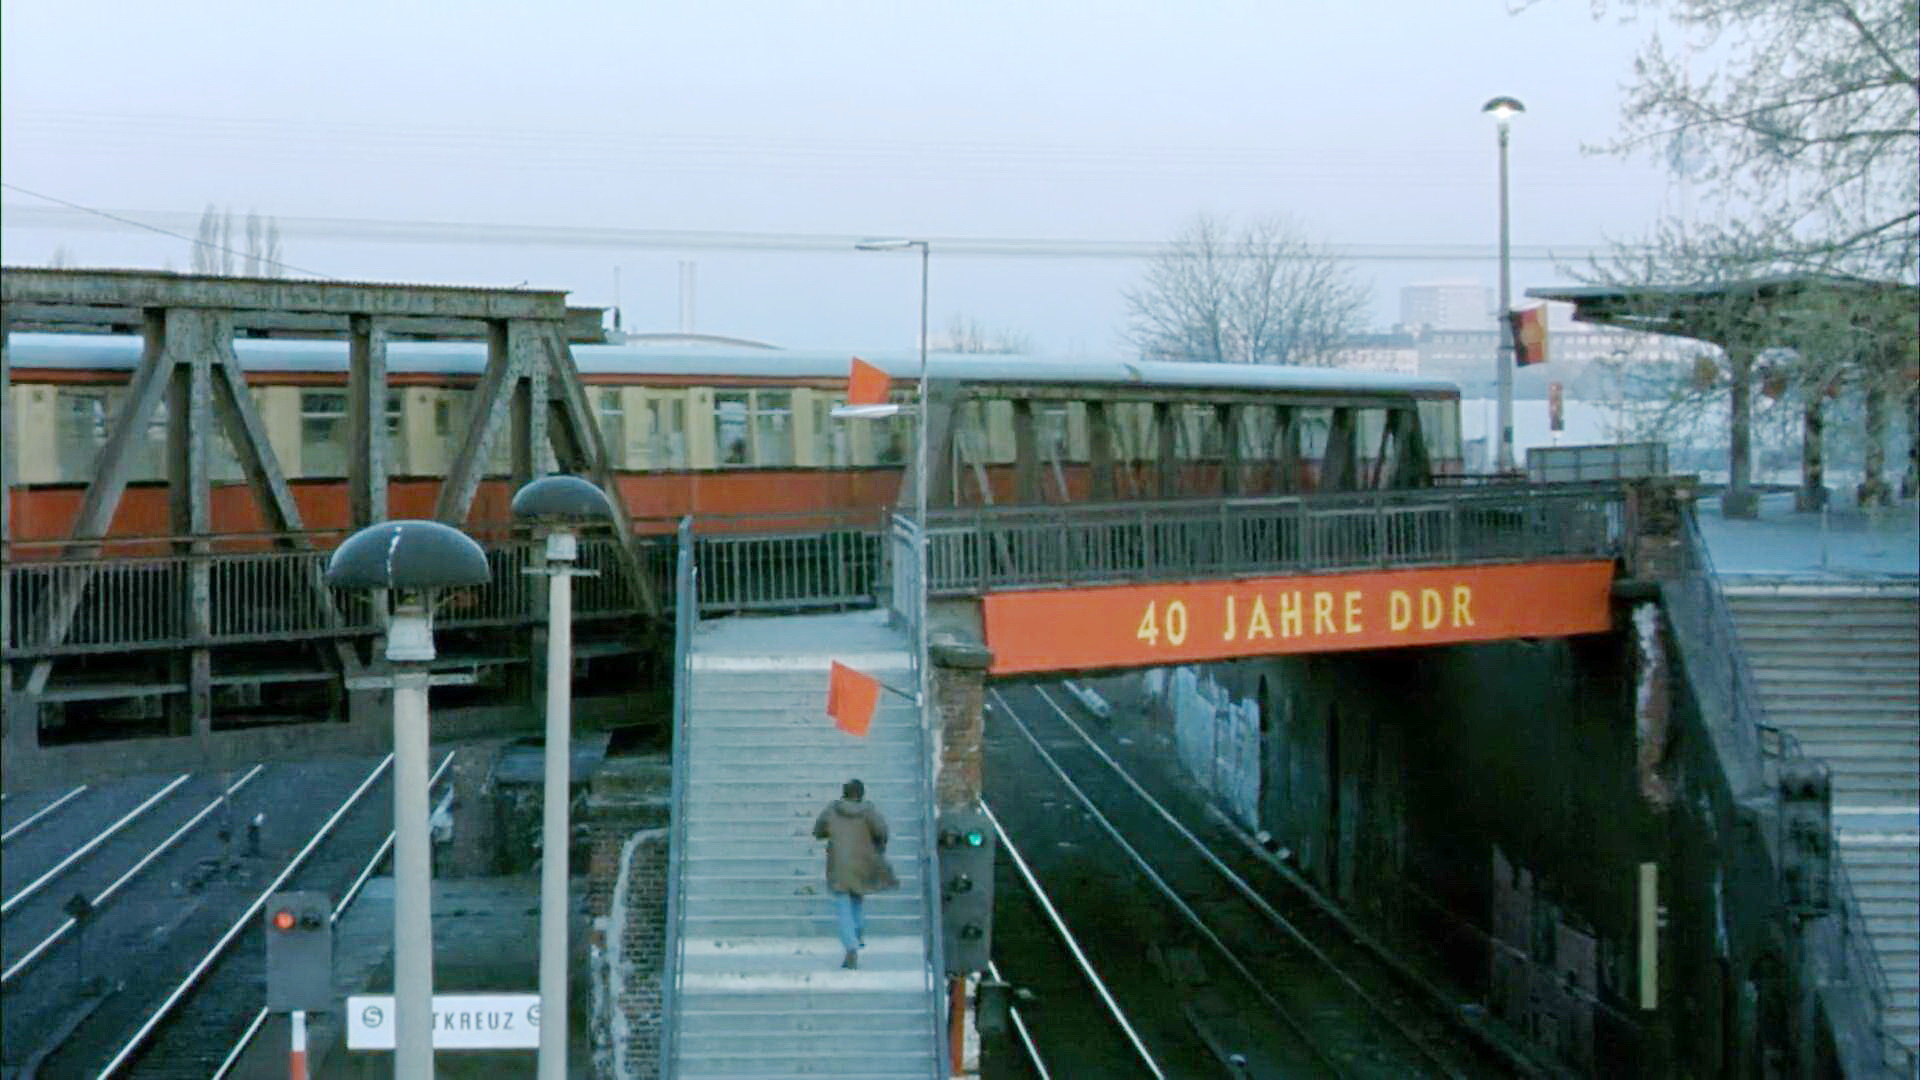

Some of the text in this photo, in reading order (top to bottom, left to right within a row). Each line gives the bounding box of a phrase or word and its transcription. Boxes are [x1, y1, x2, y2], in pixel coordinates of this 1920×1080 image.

[1136, 585, 1475, 647] 40 JAHRE DDR
[432, 1011, 514, 1031] TKREUZ
